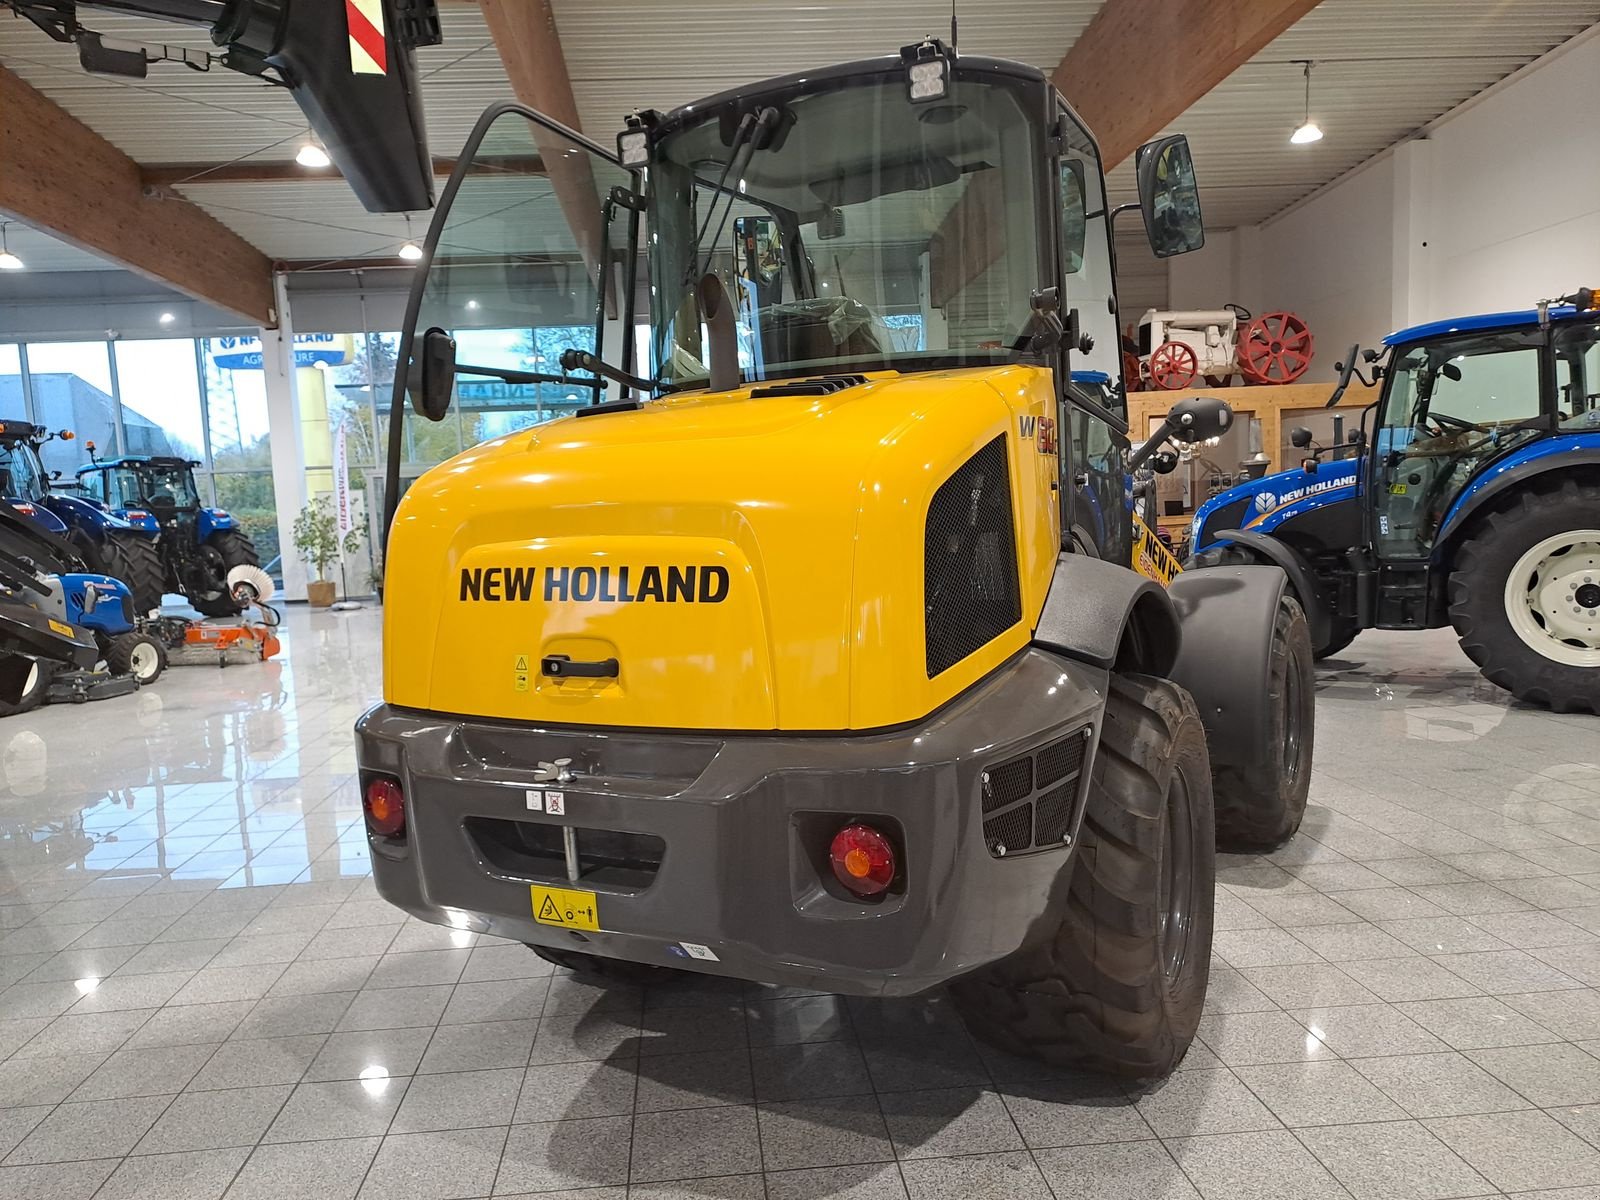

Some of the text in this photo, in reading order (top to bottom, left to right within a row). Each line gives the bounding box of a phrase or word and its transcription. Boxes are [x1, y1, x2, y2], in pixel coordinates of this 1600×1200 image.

[1279, 475, 1357, 505] NEW HOLLAND
[1145, 530, 1168, 576] NEW
[459, 565, 730, 603] NEW HOLLAND
